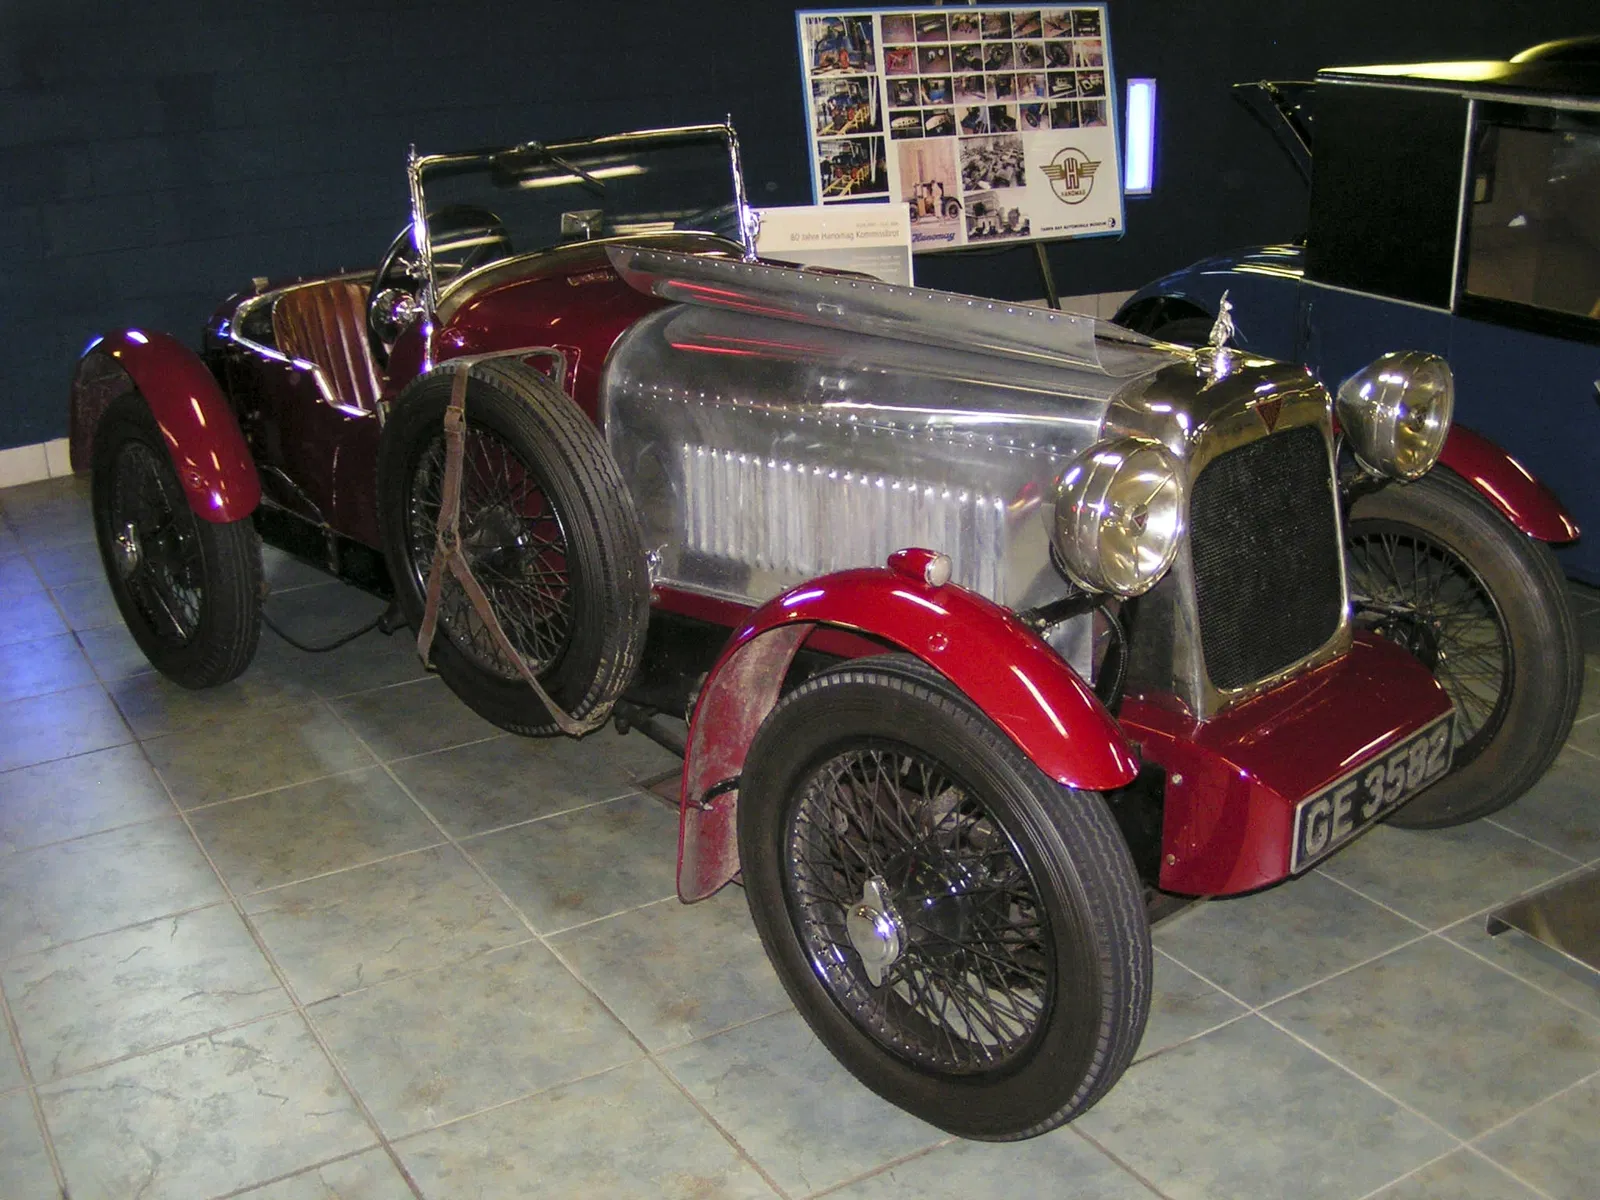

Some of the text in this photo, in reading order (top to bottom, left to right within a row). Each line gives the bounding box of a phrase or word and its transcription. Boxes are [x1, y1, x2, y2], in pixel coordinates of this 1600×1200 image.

[821, 231, 854, 241] Hanomag
[911, 232, 955, 243] Hanomag
[1306, 723, 1449, 857] GE 3582
